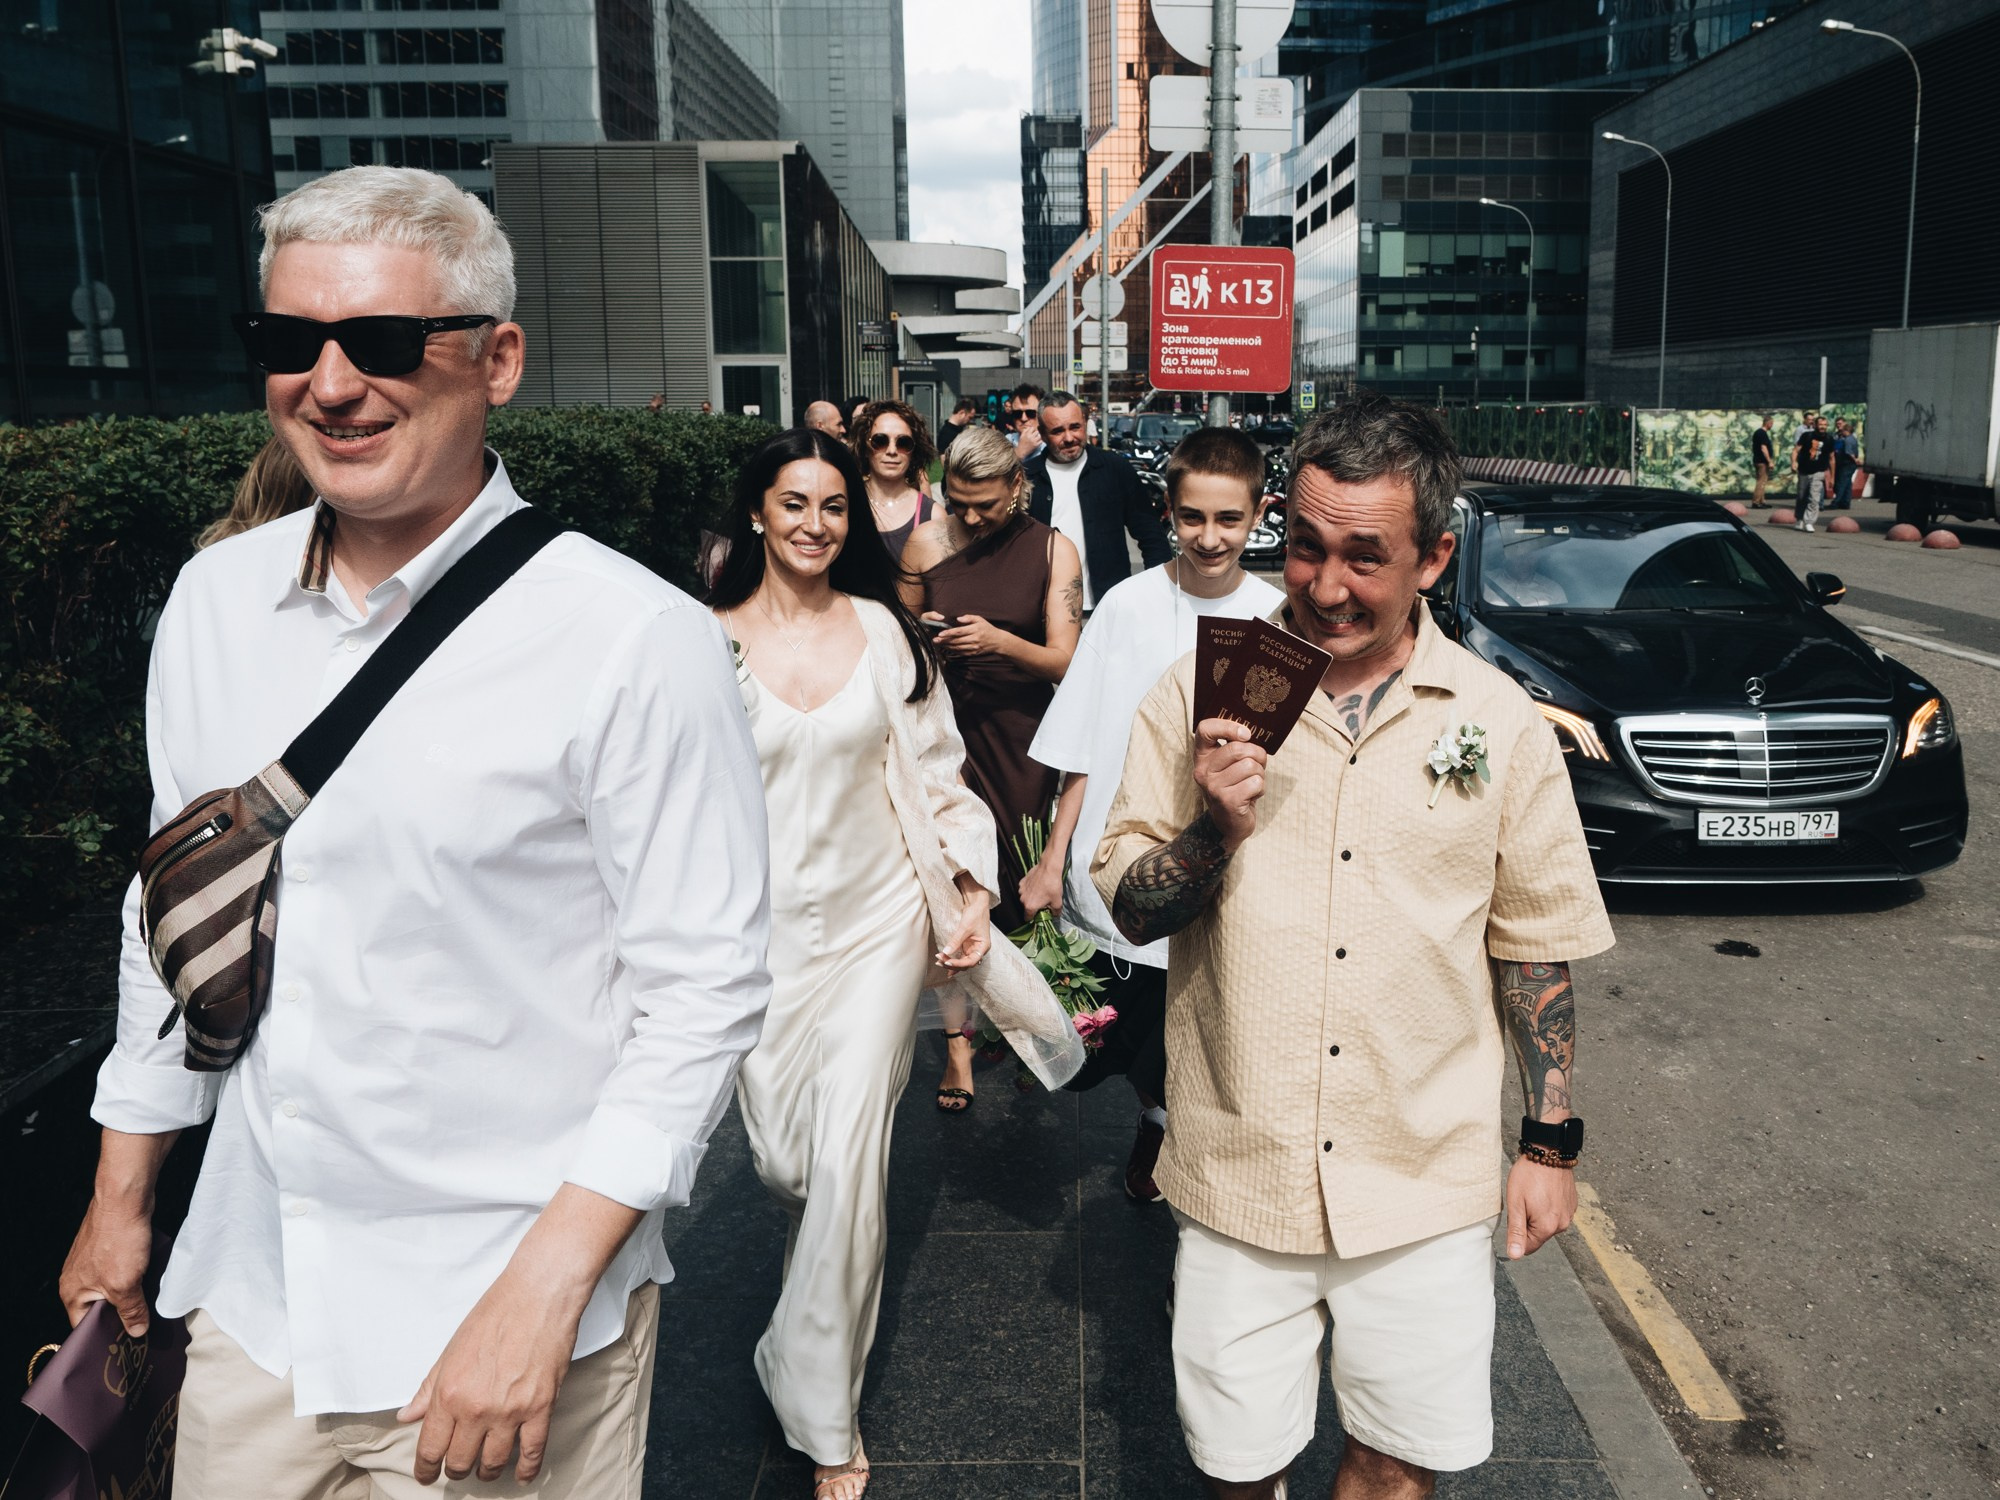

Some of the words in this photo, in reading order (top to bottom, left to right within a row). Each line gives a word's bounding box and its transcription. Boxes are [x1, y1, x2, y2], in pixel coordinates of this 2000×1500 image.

[1161, 323, 1189, 333] Зона
[1161, 335, 1262, 346] кратковременной
[1161, 346, 1219, 356] остановки
[1160, 355, 1179, 366] (до
[1181, 356, 1189, 365] 5
[1190, 356, 1217, 367] мин)
[1160, 367, 1176, 375] Kiss
[1203, 368, 1216, 376] (up
[1232, 368, 1250, 376] min)
[1259, 634, 1313, 665] РОССИЙСКАЯ
[1259, 644, 1306, 671] ФЕДЕРАЦИЯ
[1801, 813, 1833, 830] 797
